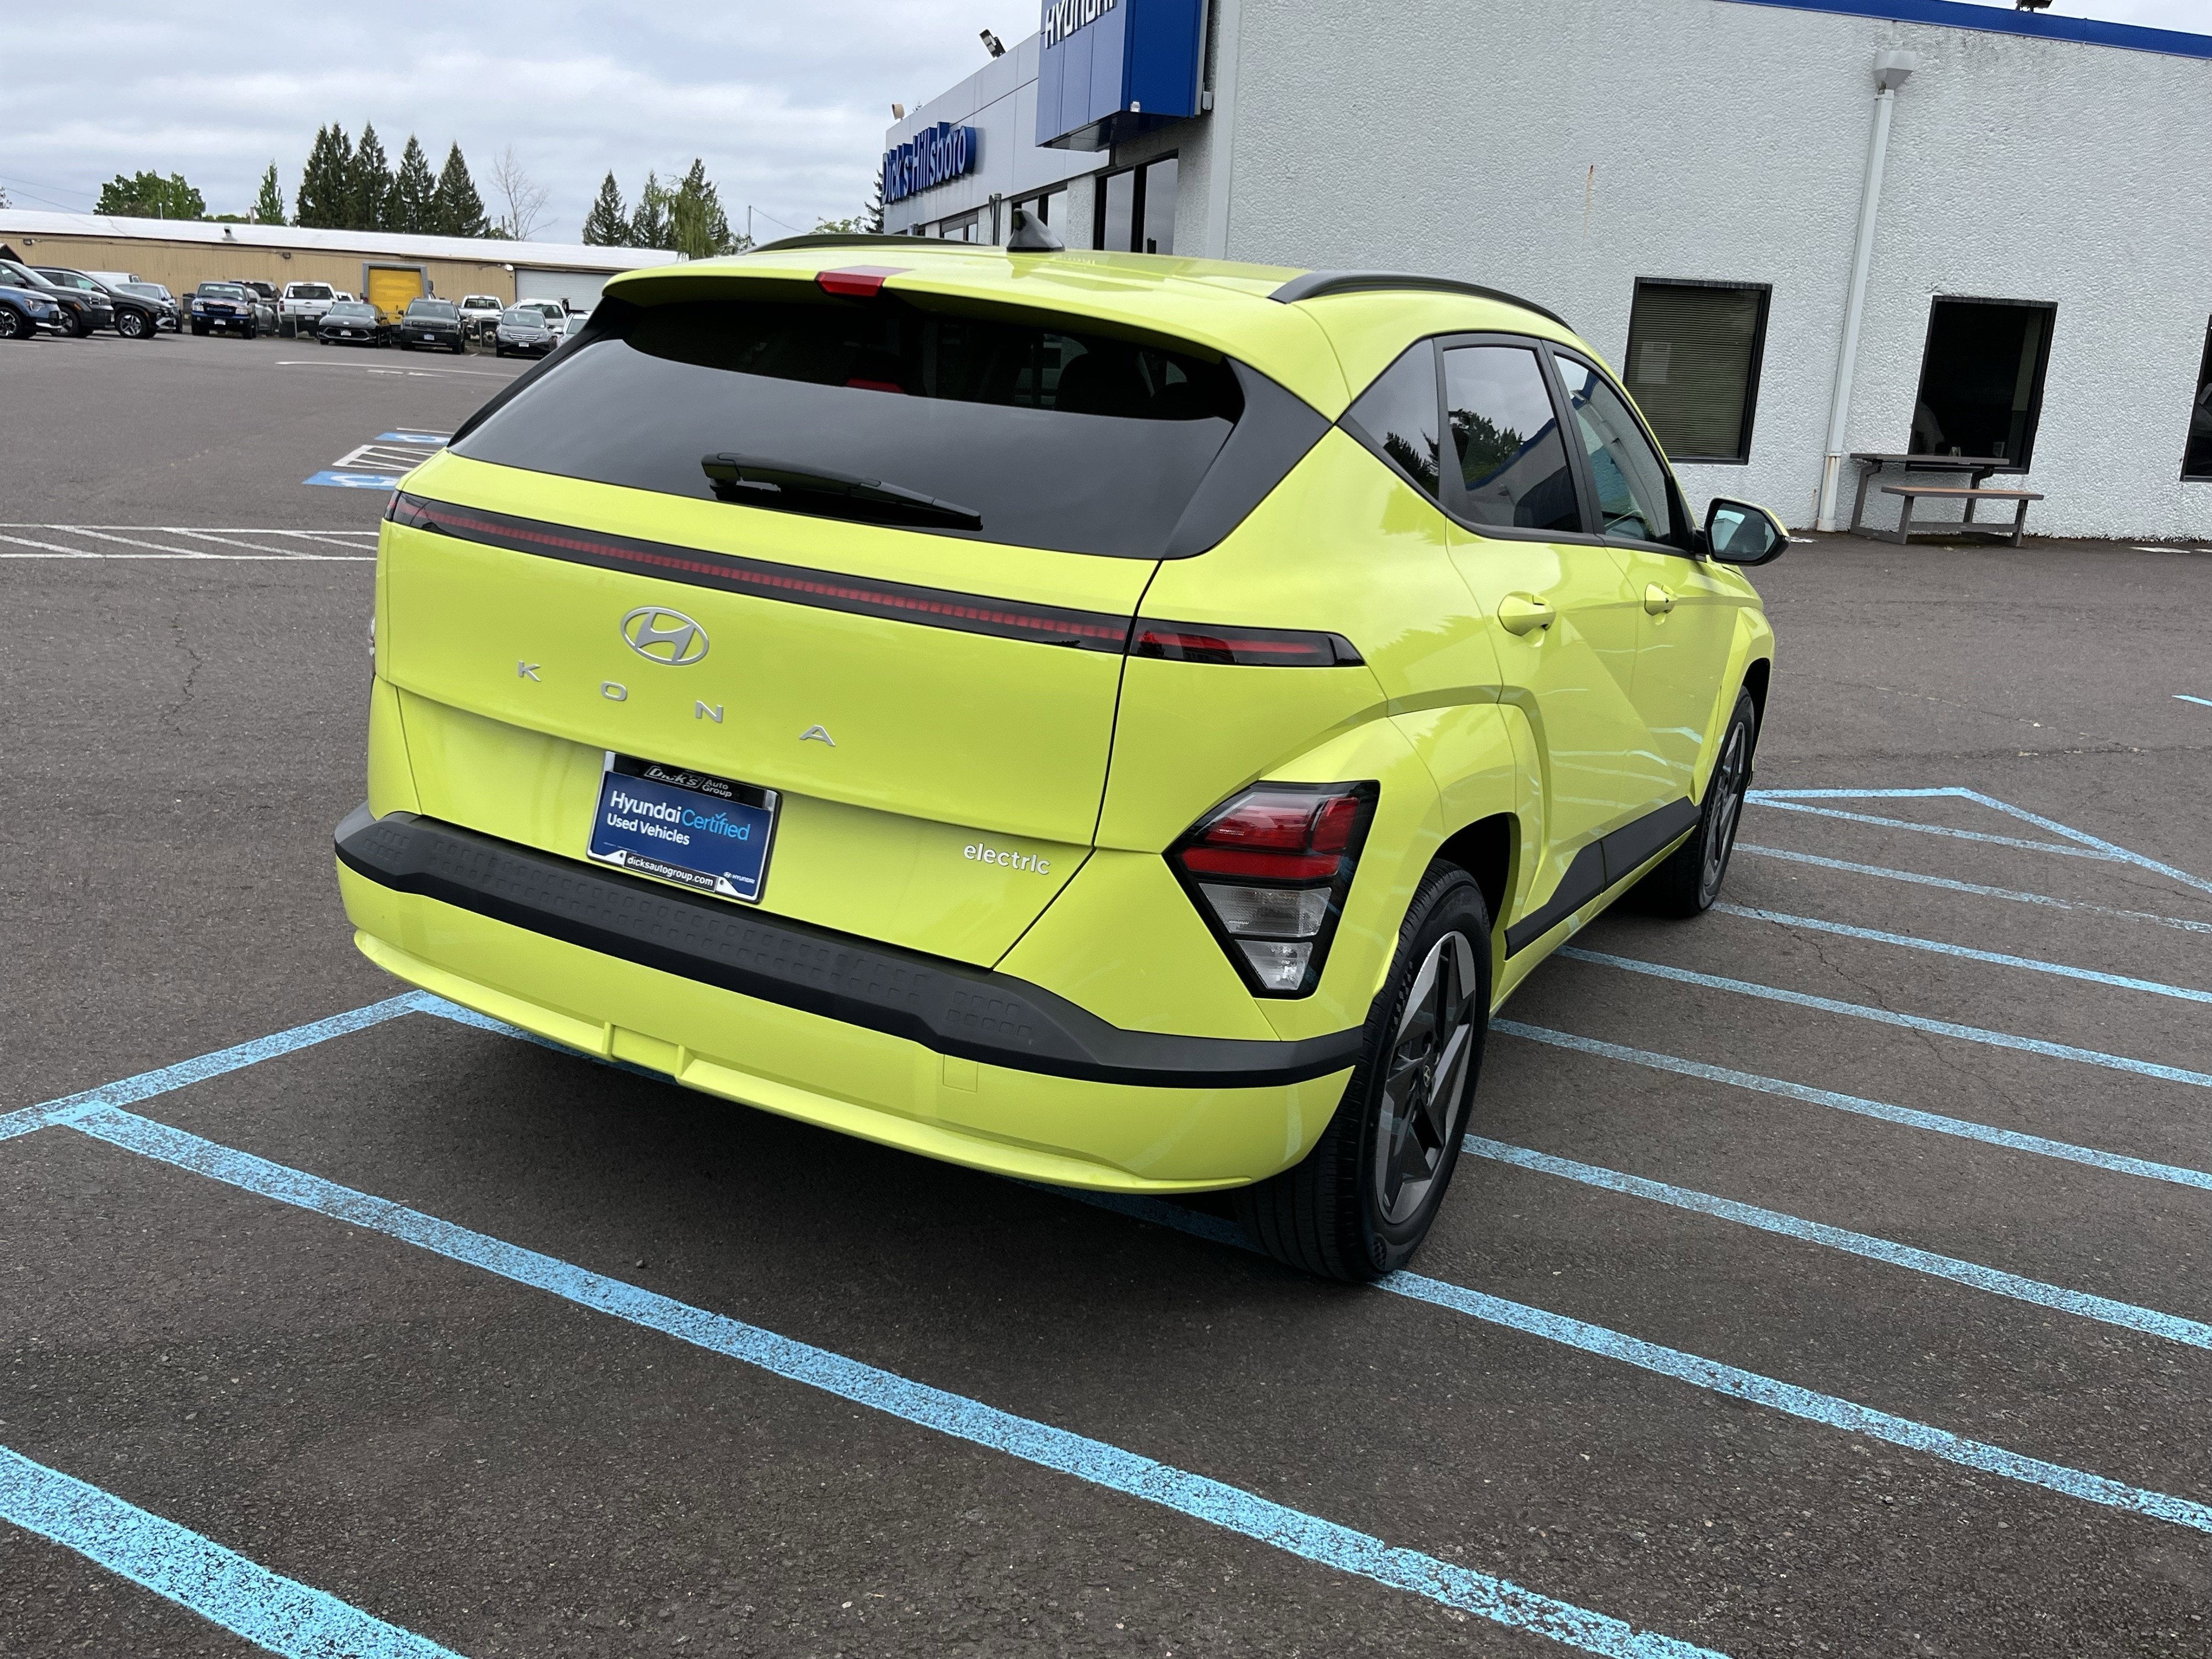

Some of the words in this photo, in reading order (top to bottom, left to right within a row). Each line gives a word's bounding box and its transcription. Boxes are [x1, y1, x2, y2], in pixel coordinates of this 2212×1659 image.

[1045, 0, 1113, 49] HYUND
[882, 143, 910, 205] Dick's
[911, 121, 968, 193] Hillsboro
[518, 661, 836, 746] KONA
[702, 785, 732, 797] Group
[705, 780, 729, 790] Auto
[607, 812, 637, 832] Used
[640, 821, 690, 845] Vehicles
[627, 856, 714, 887] dicksautogroup.com
[963, 842, 1051, 875] electric
